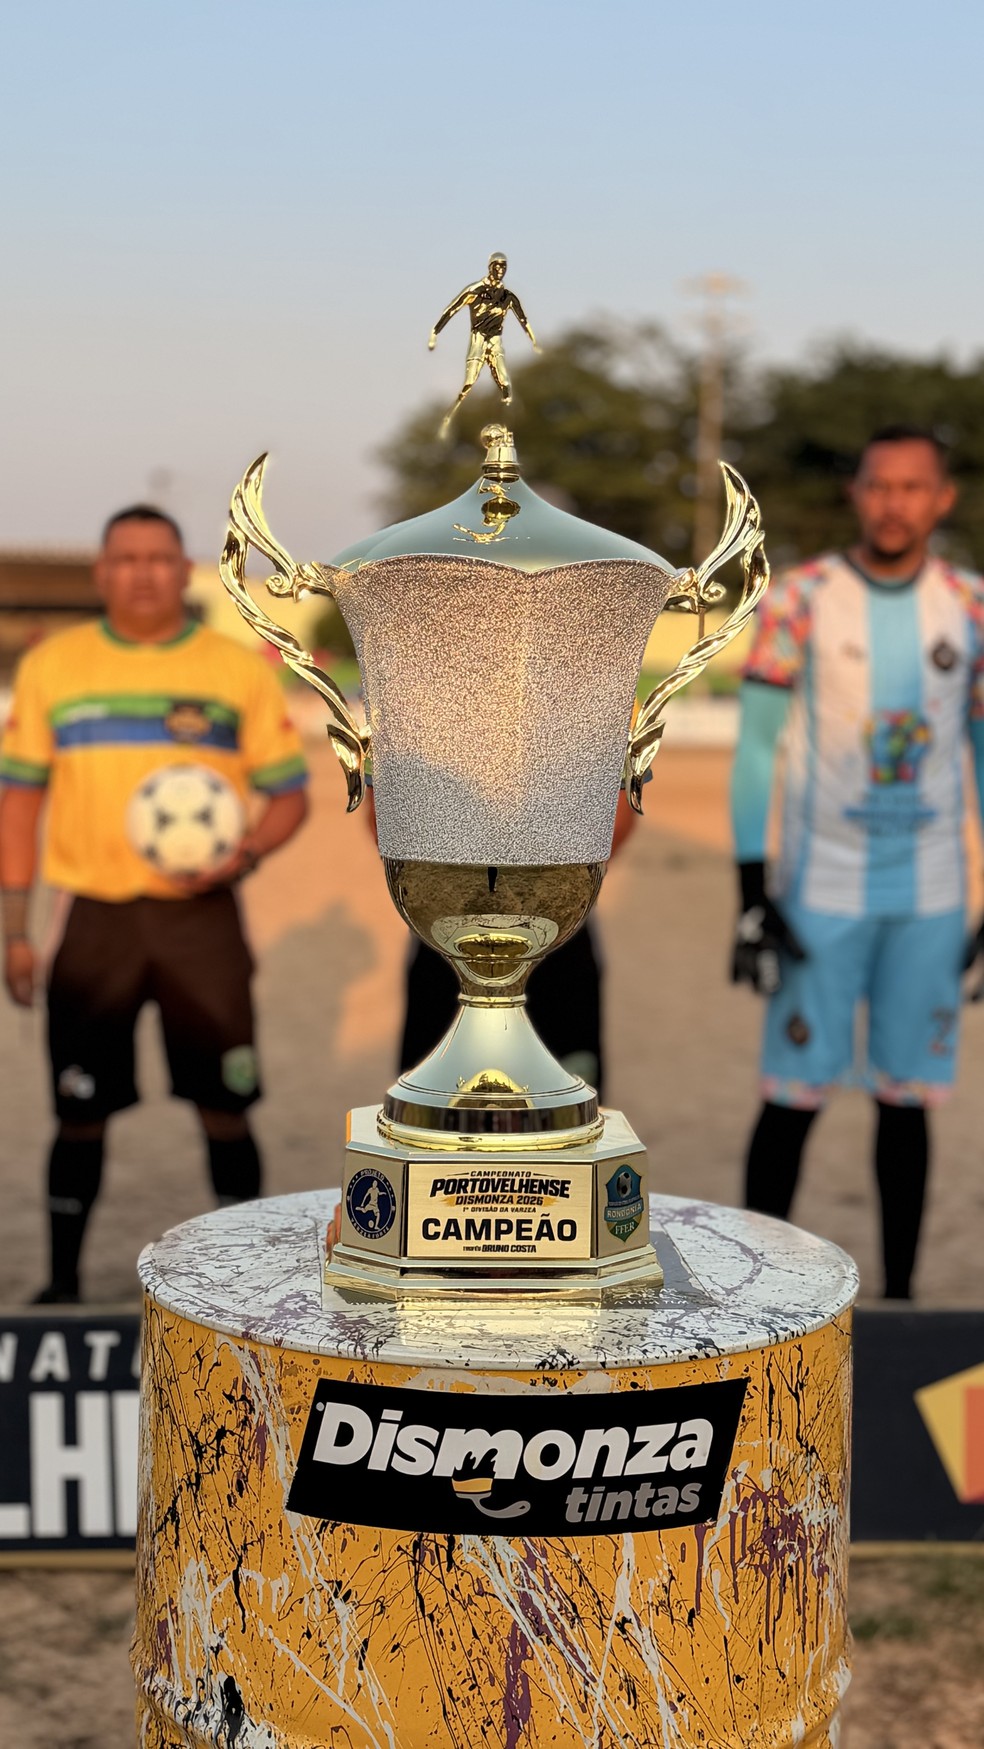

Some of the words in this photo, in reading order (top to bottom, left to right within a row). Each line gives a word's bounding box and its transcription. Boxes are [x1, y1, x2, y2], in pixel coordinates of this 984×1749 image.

[470, 1170, 531, 1178] CAMPEONATO
[430, 1178, 571, 1198] PORTOVELHENSE
[455, 1194, 514, 1205] DISMONZA
[516, 1195, 544, 1206] 2026
[422, 1213, 577, 1242] CAMPEÃO
[615, 1221, 635, 1235] FFER
[482, 1244, 509, 1253] BRUNO
[510, 1244, 537, 1253] COSTA
[313, 1401, 714, 1481] Dismonza
[565, 1482, 702, 1522] tintas
